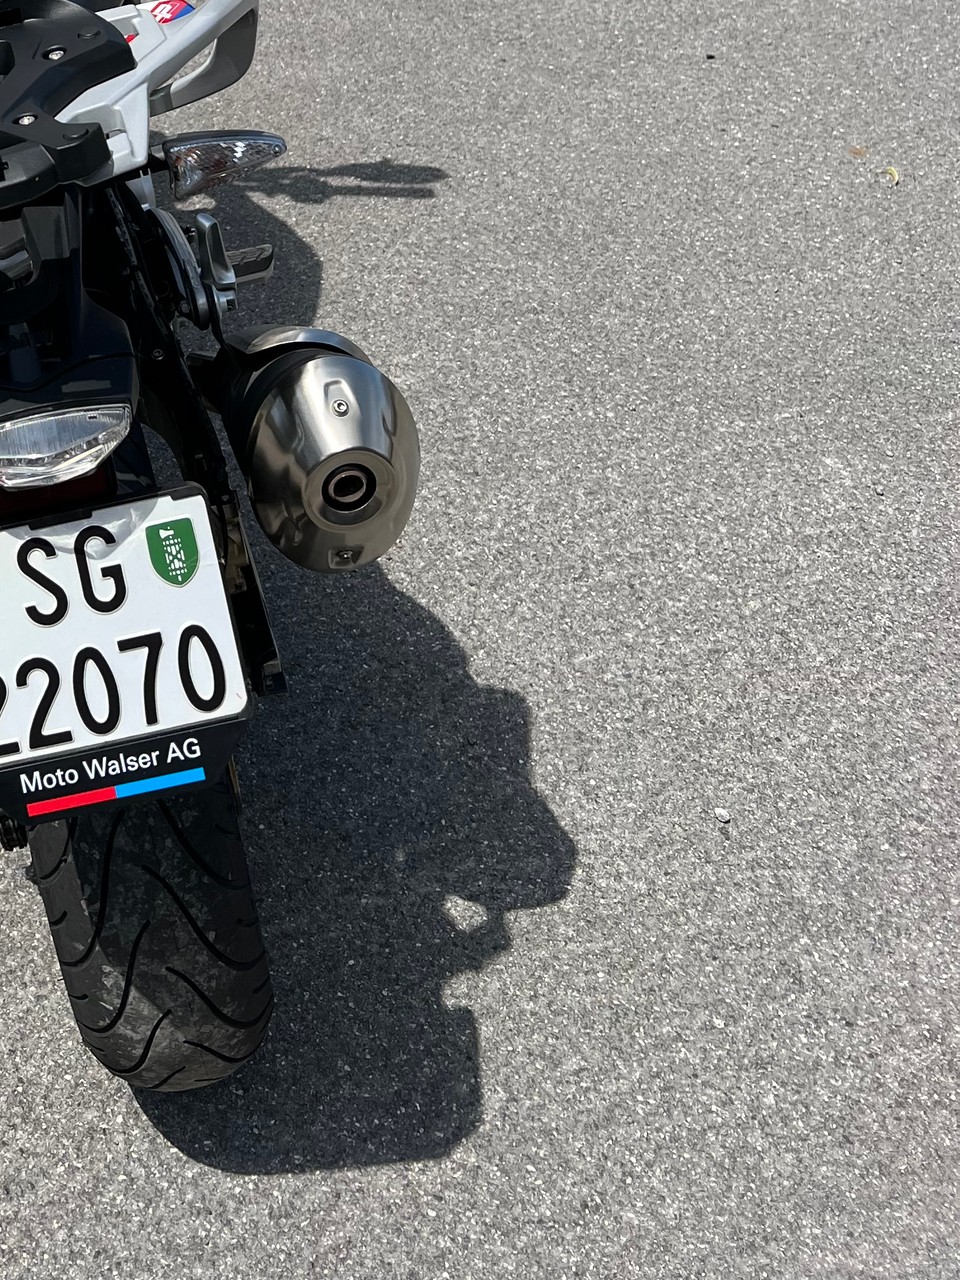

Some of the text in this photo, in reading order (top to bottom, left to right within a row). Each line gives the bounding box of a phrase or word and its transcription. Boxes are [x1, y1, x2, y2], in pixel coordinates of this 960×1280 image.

[16, 524, 128, 626] SG
[19, 737, 202, 794] Moto Walser AG
